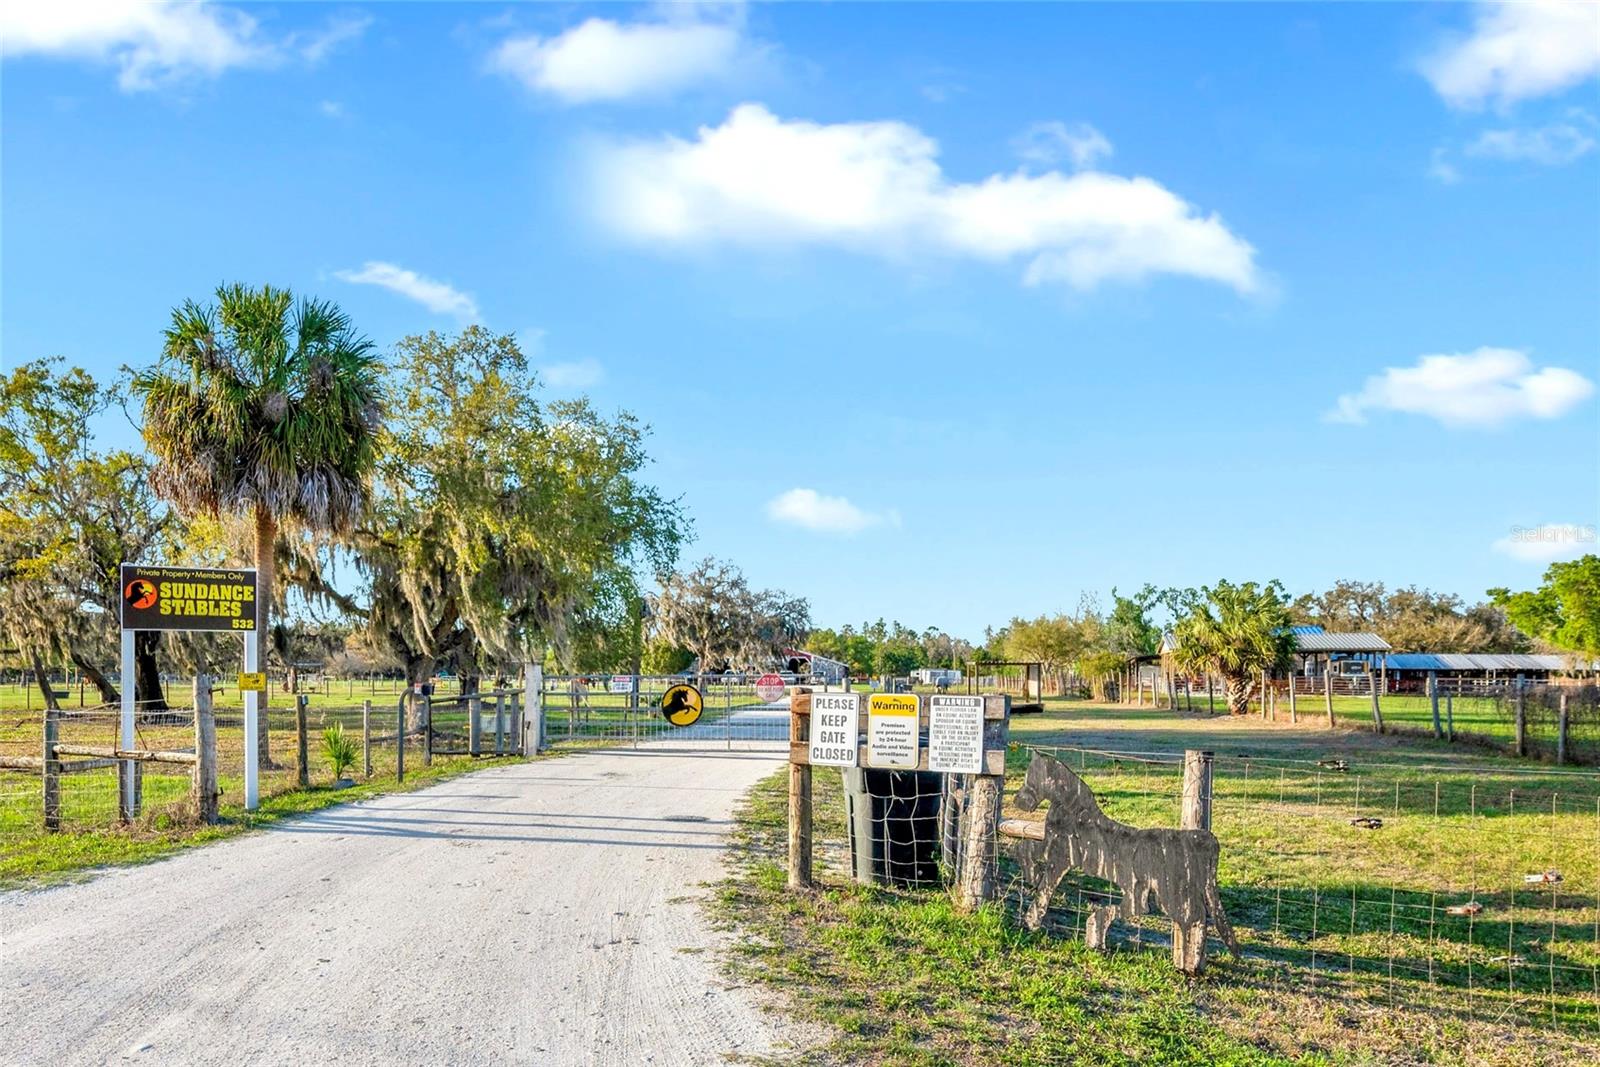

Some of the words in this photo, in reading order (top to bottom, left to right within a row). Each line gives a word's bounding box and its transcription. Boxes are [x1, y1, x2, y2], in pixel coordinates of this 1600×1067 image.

[228, 573, 244, 582] Only
[160, 582, 254, 601] SUNDANCE
[160, 600, 242, 616] STABLES
[232, 620, 254, 629] 532
[762, 677, 779, 685] STOP
[816, 698, 854, 710] PLEASE
[872, 702, 915, 712] Warning
[939, 698, 975, 706] WARNING
[821, 714, 847, 727] KEEP
[821, 731, 846, 744] GATE
[813, 748, 853, 761] CLOSED
